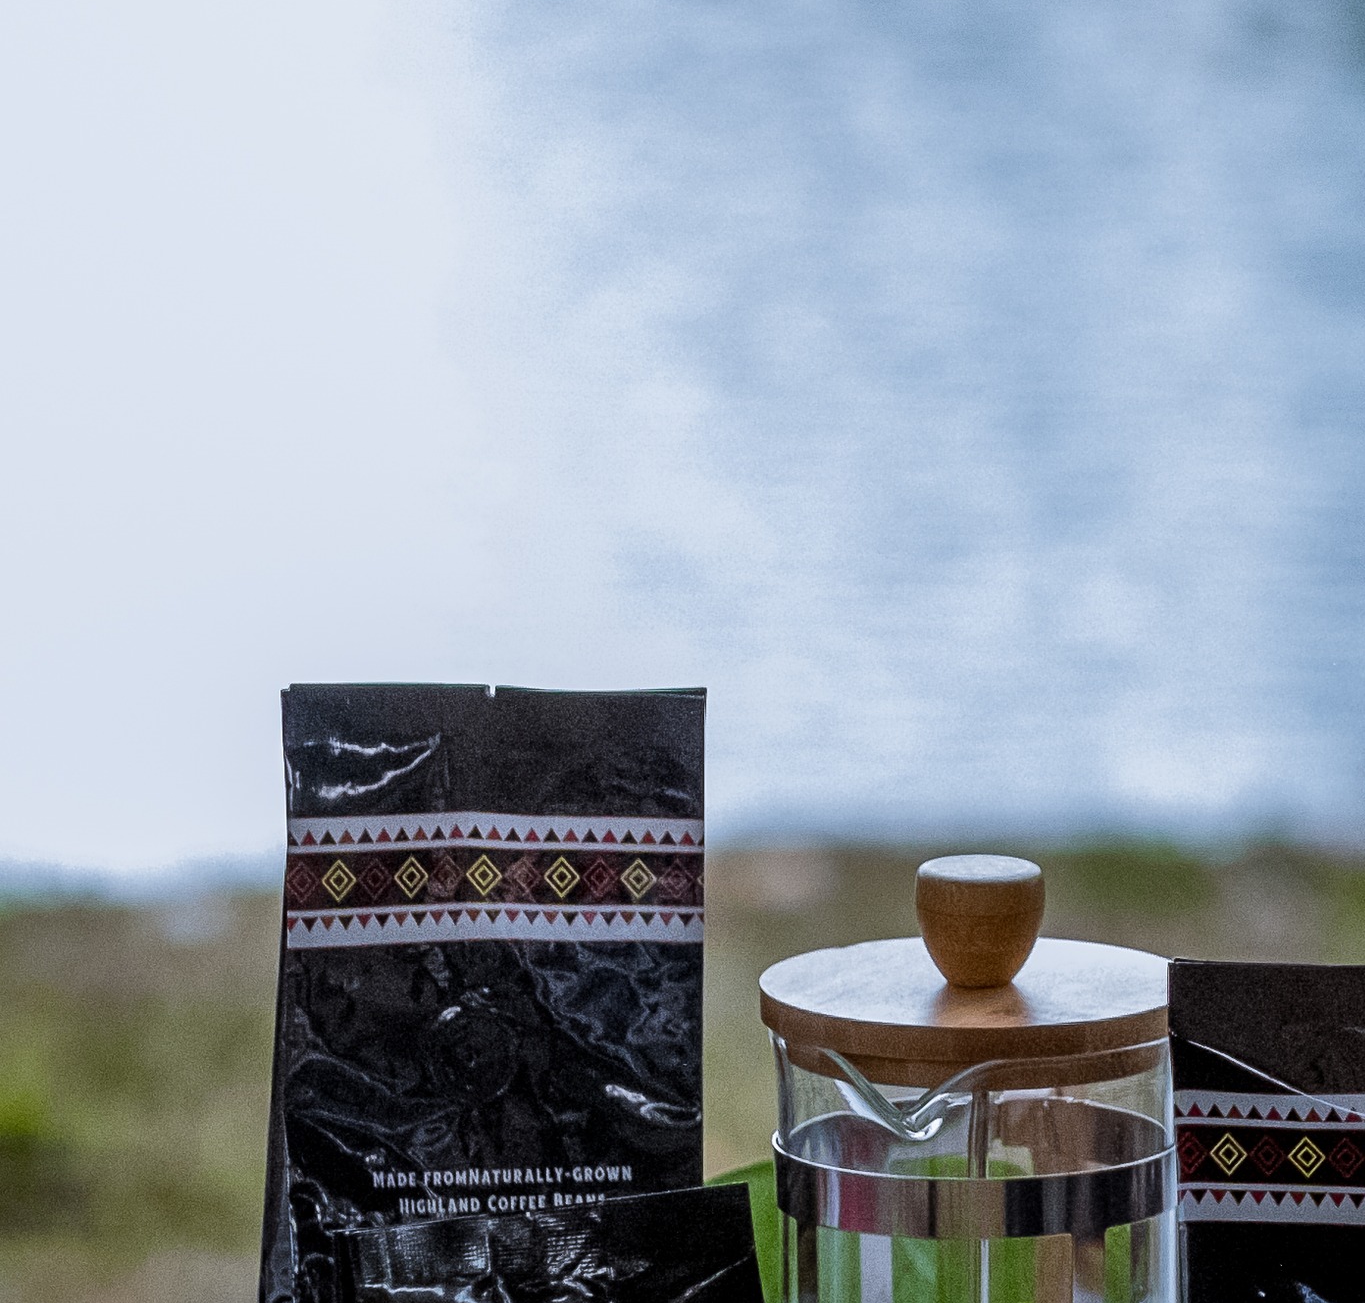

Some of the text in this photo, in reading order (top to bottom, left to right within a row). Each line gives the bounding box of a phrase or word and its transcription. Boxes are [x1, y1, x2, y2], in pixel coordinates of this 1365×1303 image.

[372, 1171, 416, 1189] MADE
[399, 1196, 480, 1215] HIGHLAND
[488, 1195, 546, 1212] COFFEE
